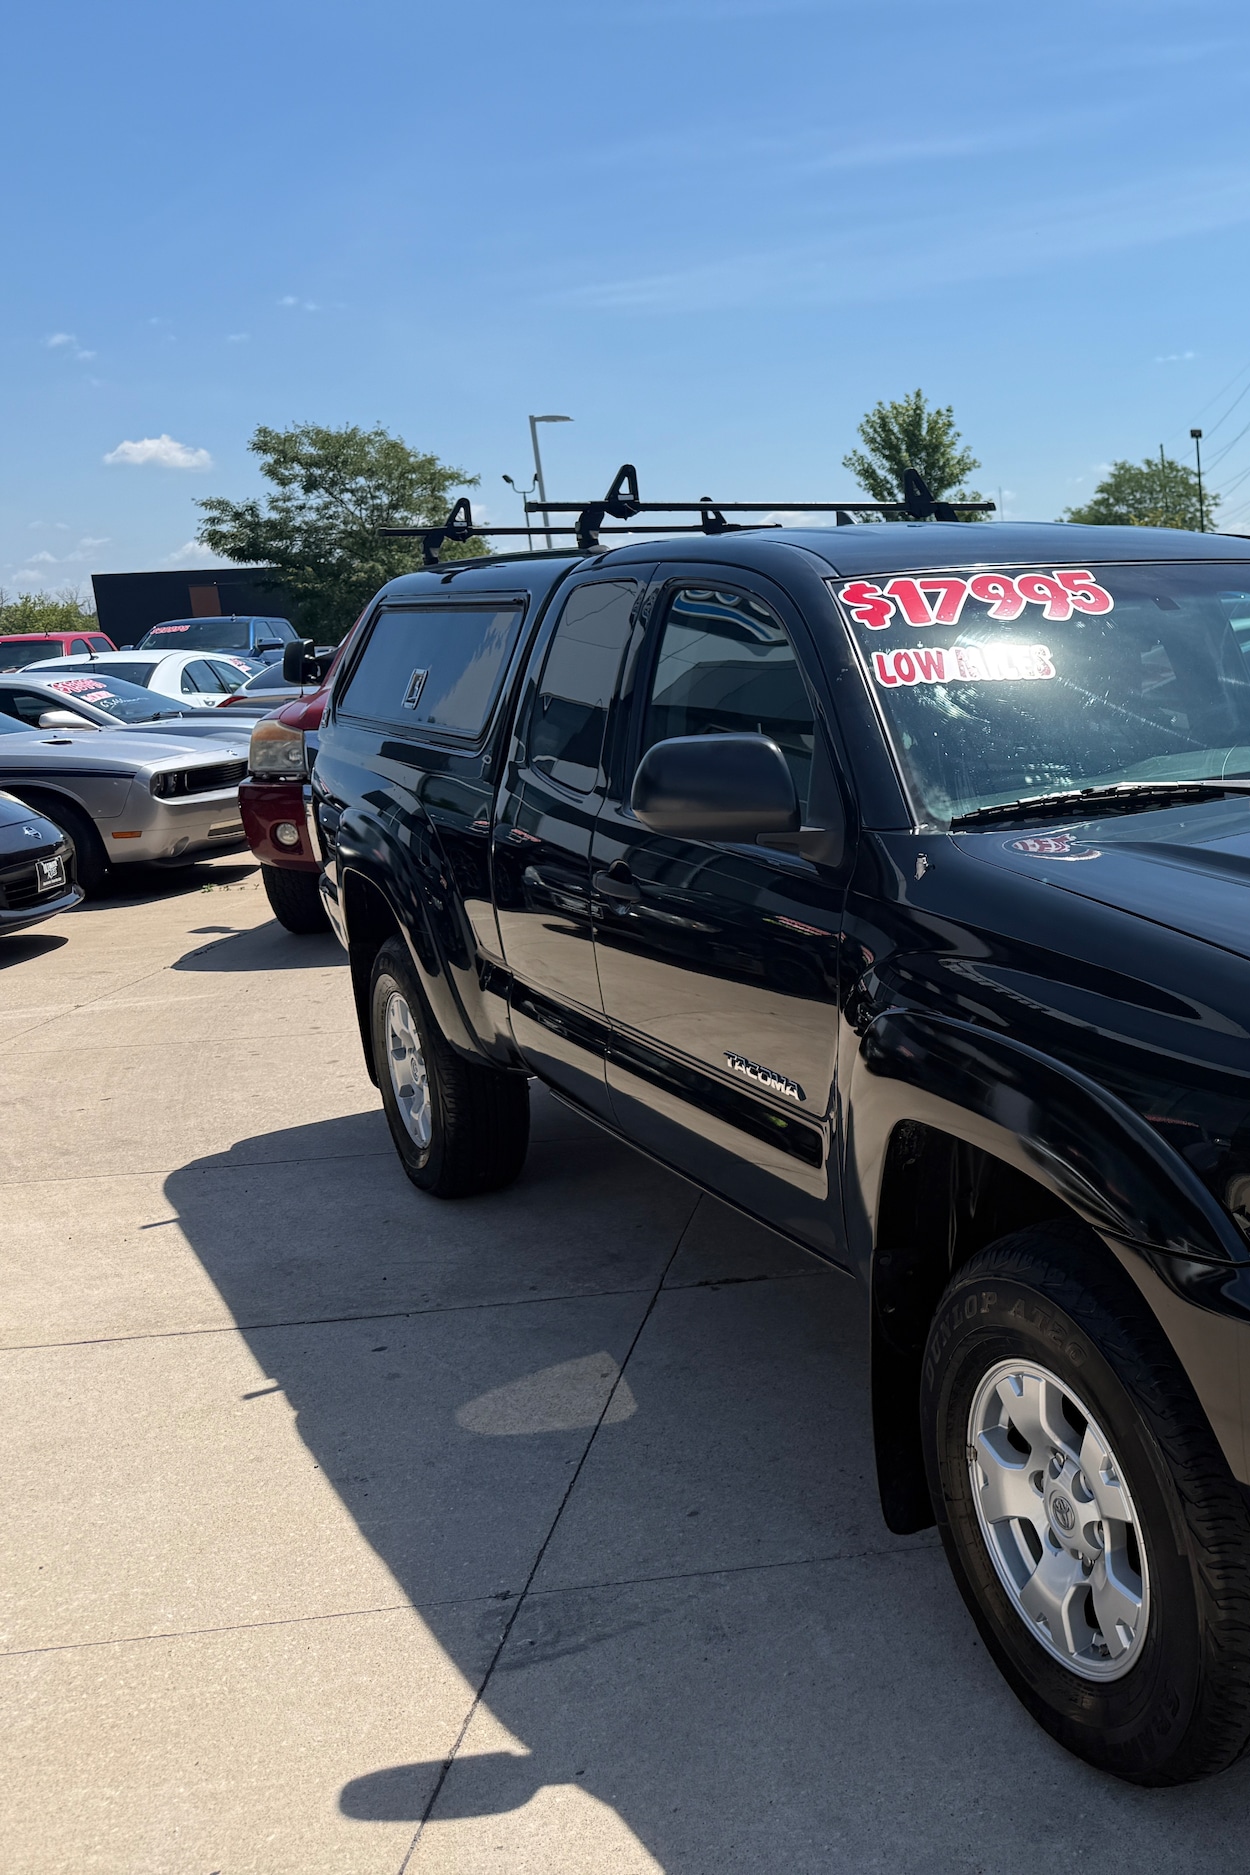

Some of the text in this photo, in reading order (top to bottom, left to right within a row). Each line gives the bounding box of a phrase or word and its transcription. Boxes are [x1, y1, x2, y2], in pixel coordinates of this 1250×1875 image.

[841, 571, 1112, 629] $17995
[874, 649, 947, 687] LOW
[722, 1050, 802, 1101] TACOMA
[925, 1292, 1088, 1392] DUNLOP AT20
